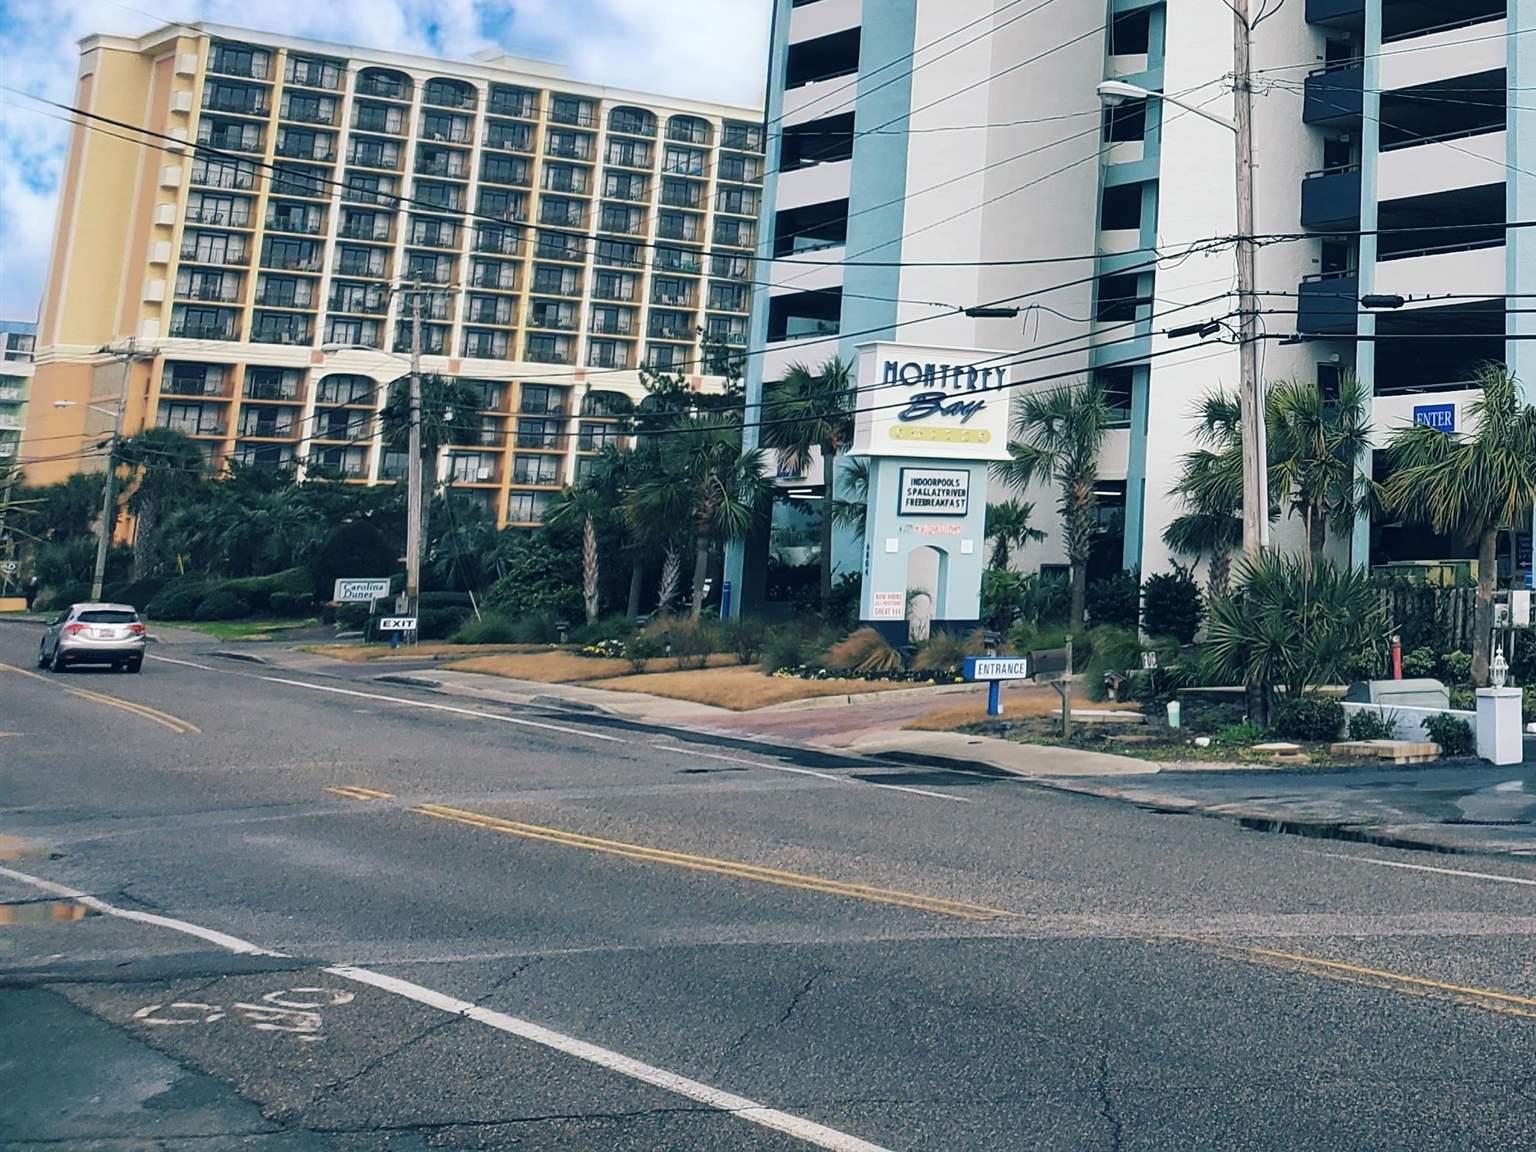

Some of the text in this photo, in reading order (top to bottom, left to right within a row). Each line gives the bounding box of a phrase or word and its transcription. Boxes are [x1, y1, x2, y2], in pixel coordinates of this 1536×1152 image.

[883, 360, 1007, 391] MONTEREY
[897, 391, 987, 424] Bay
[1416, 411, 1452, 426] ENTER
[343, 582, 384, 591] Carolina
[383, 619, 414, 628] EXIT
[978, 662, 1025, 675] ENTRANCE
